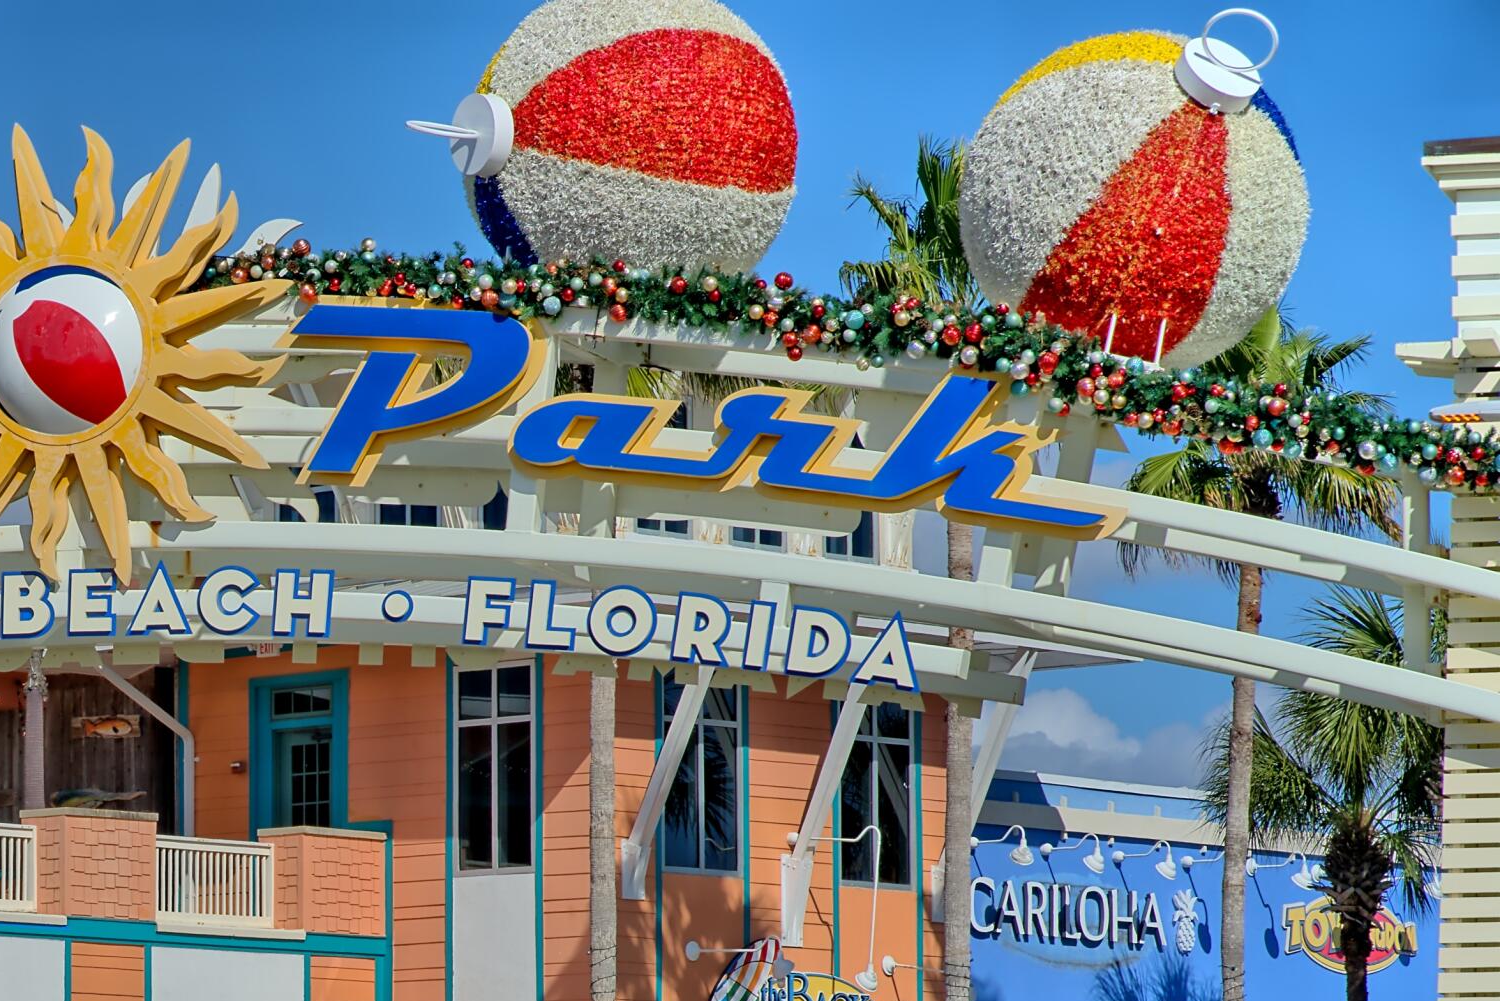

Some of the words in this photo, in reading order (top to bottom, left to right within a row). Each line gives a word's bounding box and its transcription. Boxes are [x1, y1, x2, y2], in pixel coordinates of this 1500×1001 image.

[275, 298, 1128, 541] Park
[0, 560, 335, 639] BEACH
[462, 576, 920, 693] FLORIDA
[970, 876, 1168, 947] CARILOHA
